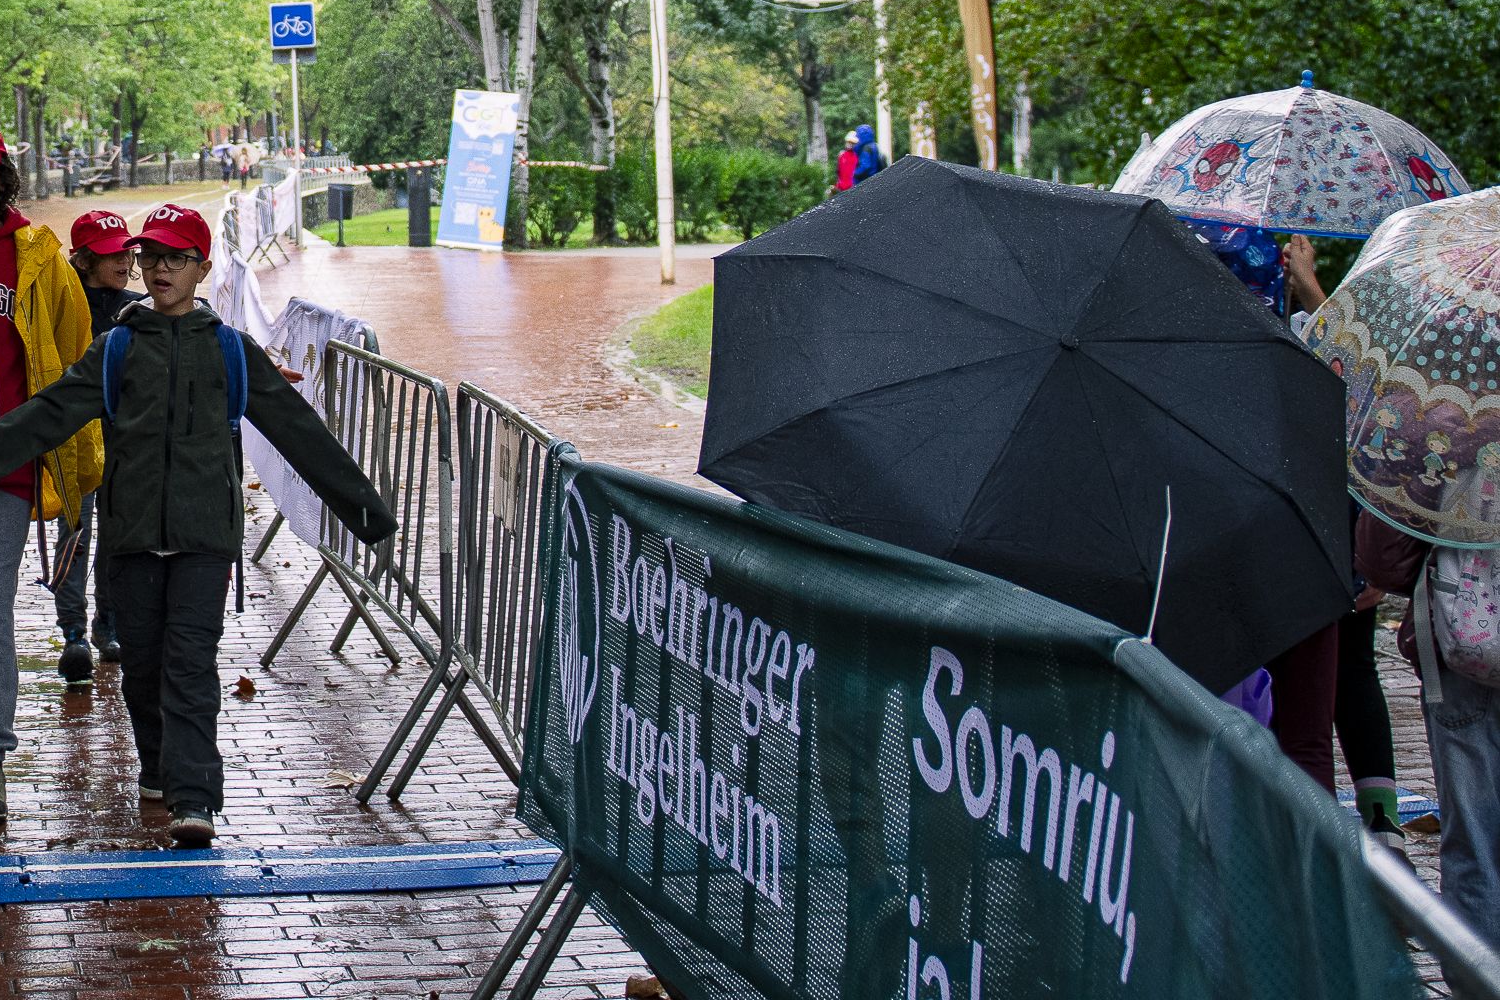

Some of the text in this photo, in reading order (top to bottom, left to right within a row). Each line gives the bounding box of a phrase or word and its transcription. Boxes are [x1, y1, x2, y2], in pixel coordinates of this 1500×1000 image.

[96, 216, 125, 230] TOT
[148, 206, 184, 223] TOT
[610, 514, 815, 737] Boehringer
[606, 663, 782, 908] Ingelheim
[912, 645, 1136, 985] Somriu,
